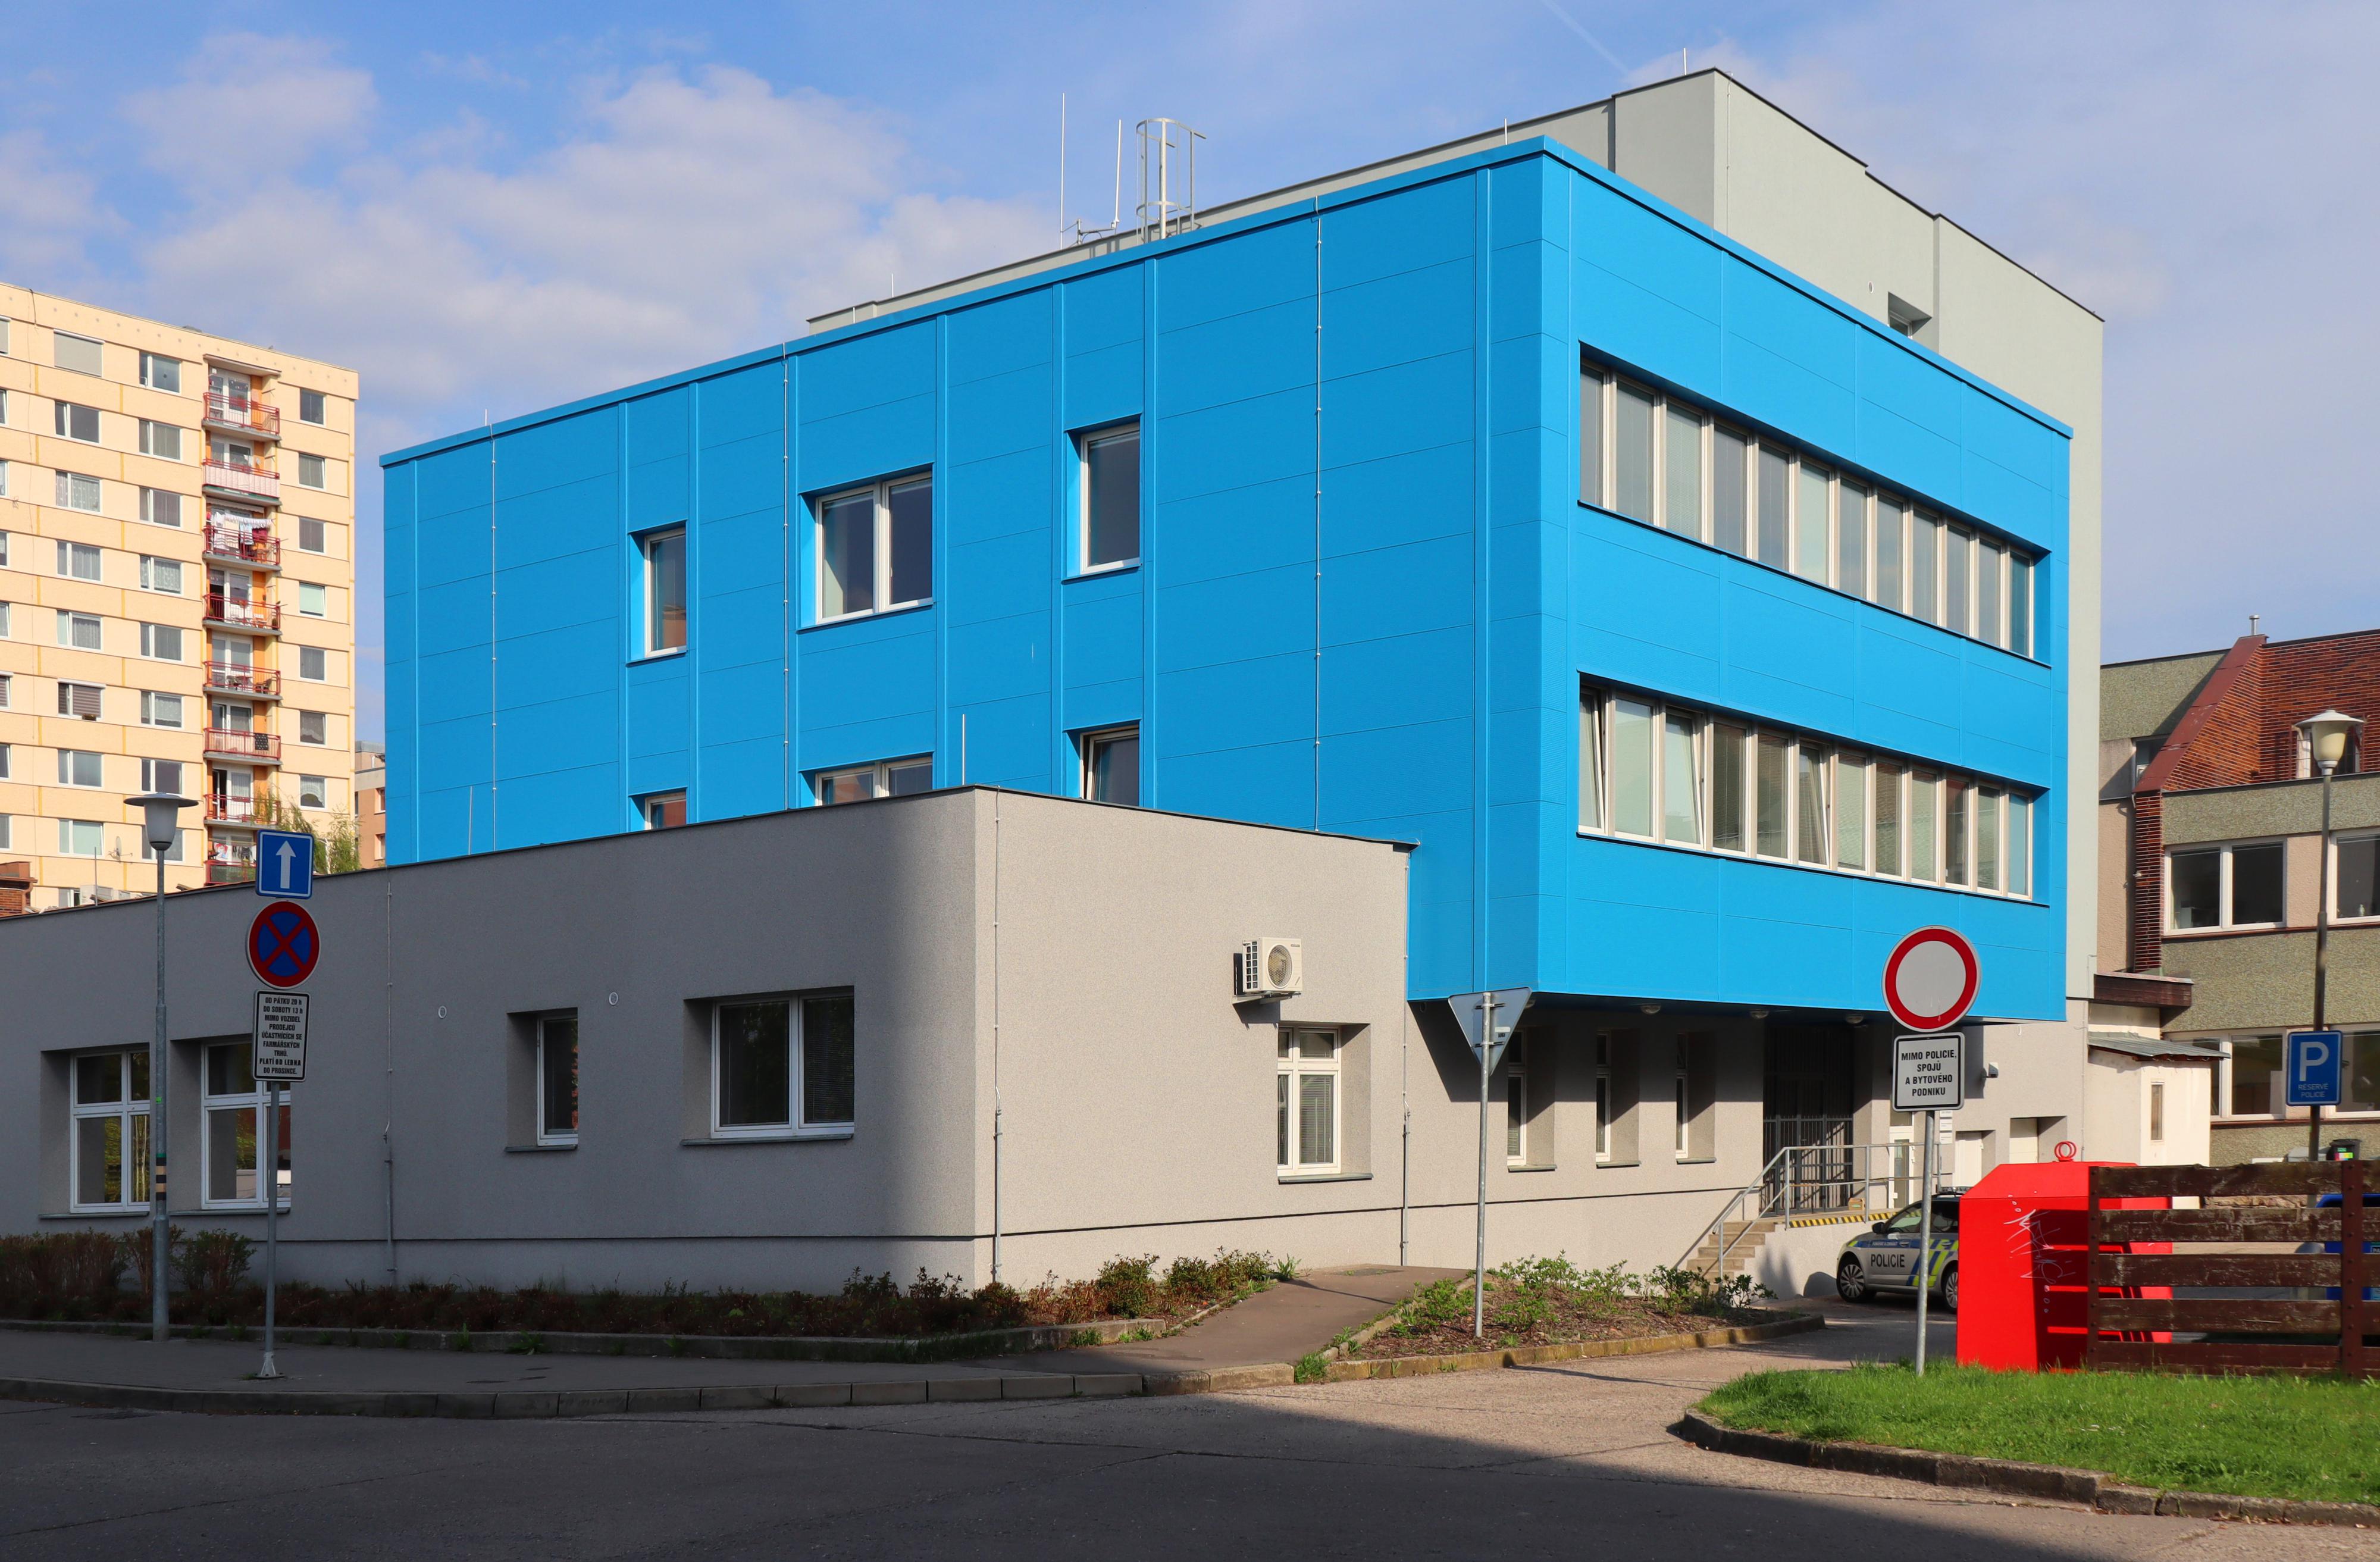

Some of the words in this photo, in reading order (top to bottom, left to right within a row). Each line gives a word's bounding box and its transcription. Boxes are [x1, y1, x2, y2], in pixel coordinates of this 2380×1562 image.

[274, 996, 290, 1004] PÁTKU
[261, 1030, 295, 1040] ÚČASTNÍCÍCH
[263, 1040, 300, 1048] FARMÁŘSKÝCH
[274, 1048, 288, 1057] TRHŮ.
[1901, 1051, 1923, 1061] MIMO
[1925, 1050, 1957, 1059] POLICIE,
[1917, 1060, 1941, 1072] SPOJŮ
[2299, 1041, 2329, 1082] P
[1905, 1076, 1911, 1085] A
[1912, 1072, 1953, 1084] BYTOVÉHO
[1912, 1087, 1946, 1097] PODNIKU
[1871, 1254, 1905, 1268] POLICIE
